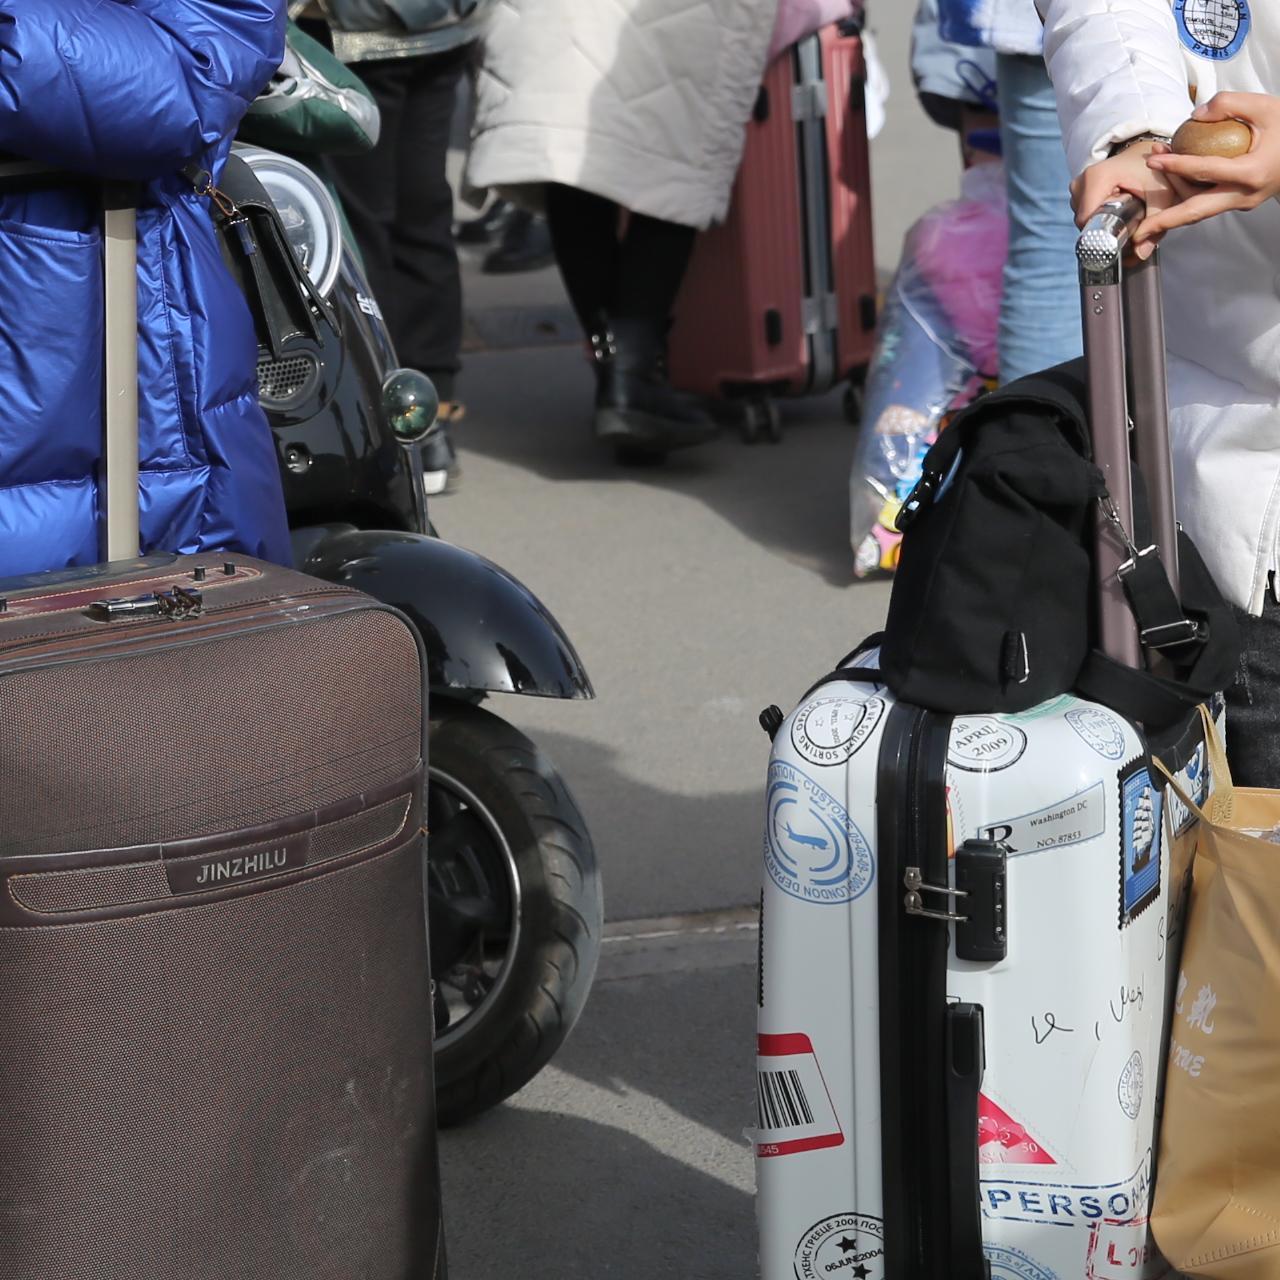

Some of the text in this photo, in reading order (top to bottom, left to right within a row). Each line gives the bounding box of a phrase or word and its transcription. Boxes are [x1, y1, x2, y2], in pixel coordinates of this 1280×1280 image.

[1192, 43, 1229, 58] PARIS
[954, 723, 970, 734] 20
[955, 725, 999, 750] APRIL
[798, 735, 839, 760] SORTING
[972, 737, 1008, 757] 2009
[1029, 799, 1089, 827] Washington DC
[1058, 830, 1082, 843] 87853
[196, 848, 288, 884] JINZHILU
[804, 885, 850, 900] LONDON
[1021, 1141, 1039, 1153] 50
[987, 1162, 1152, 1218] PERSONAL
